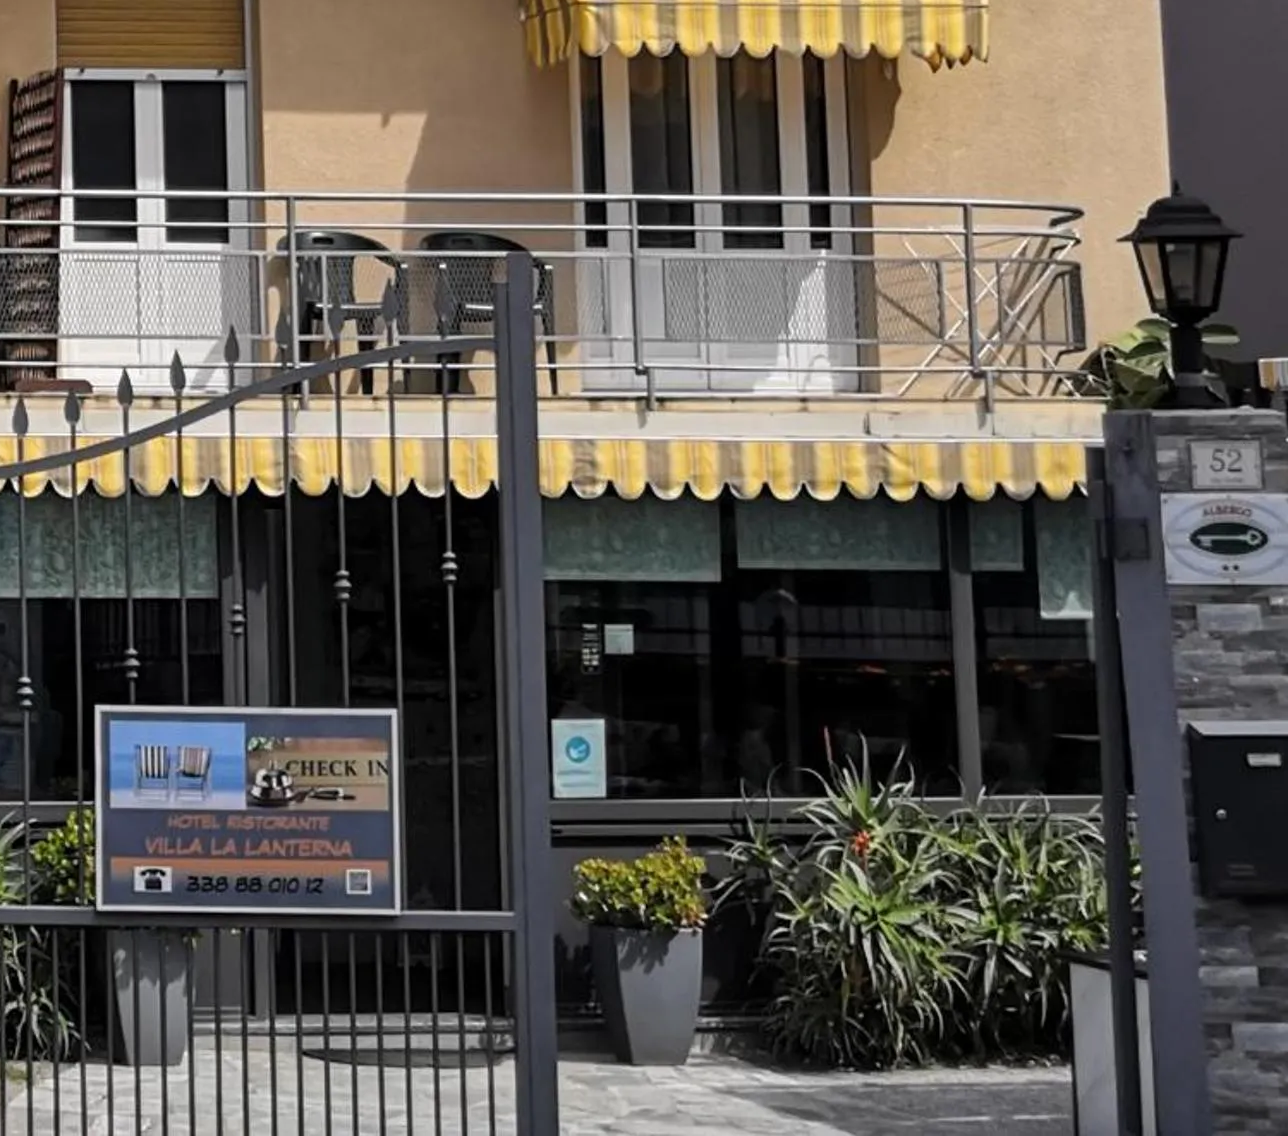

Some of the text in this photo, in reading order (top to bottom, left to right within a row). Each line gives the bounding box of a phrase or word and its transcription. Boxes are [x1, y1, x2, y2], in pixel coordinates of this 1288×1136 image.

[1210, 448, 1243, 472] 52
[285, 759, 389, 777] CHECK IN
[167, 815, 331, 831] HOTEL RISTORANTE
[144, 837, 354, 857] VILLA LA LANTERNA
[185, 875, 229, 893] 338
[234, 876, 262, 893] 88
